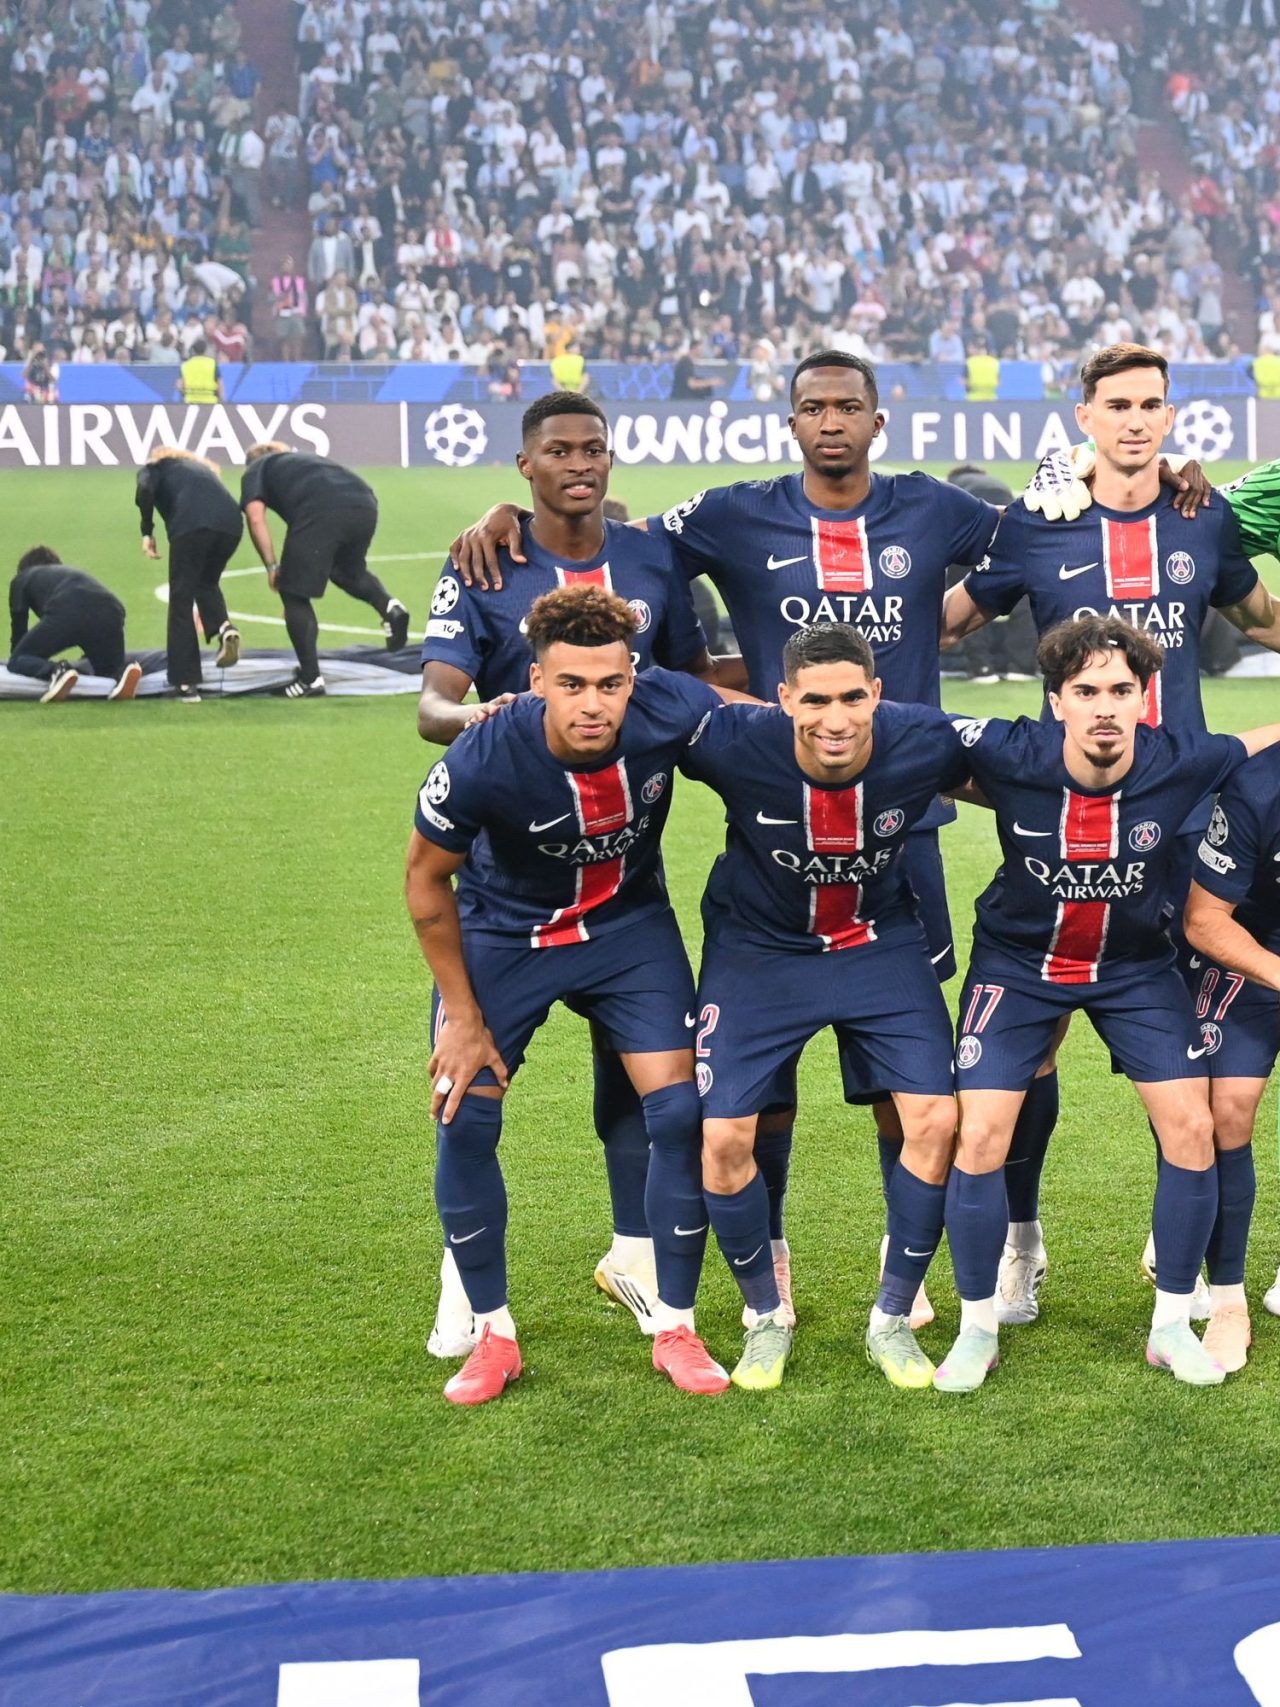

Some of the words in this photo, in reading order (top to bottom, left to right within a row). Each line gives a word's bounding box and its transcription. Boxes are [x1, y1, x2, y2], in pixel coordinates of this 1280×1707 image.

[912, 412, 1074, 460] FINA
[780, 596, 904, 629] QATAR
[771, 847, 893, 873] QATAR
[1024, 856, 1147, 886] QATAR
[1051, 880, 1144, 899] AIRWAYS
[962, 984, 1005, 1034] 17
[1195, 967, 1246, 1021] 87
[695, 1003, 720, 1058] 2
